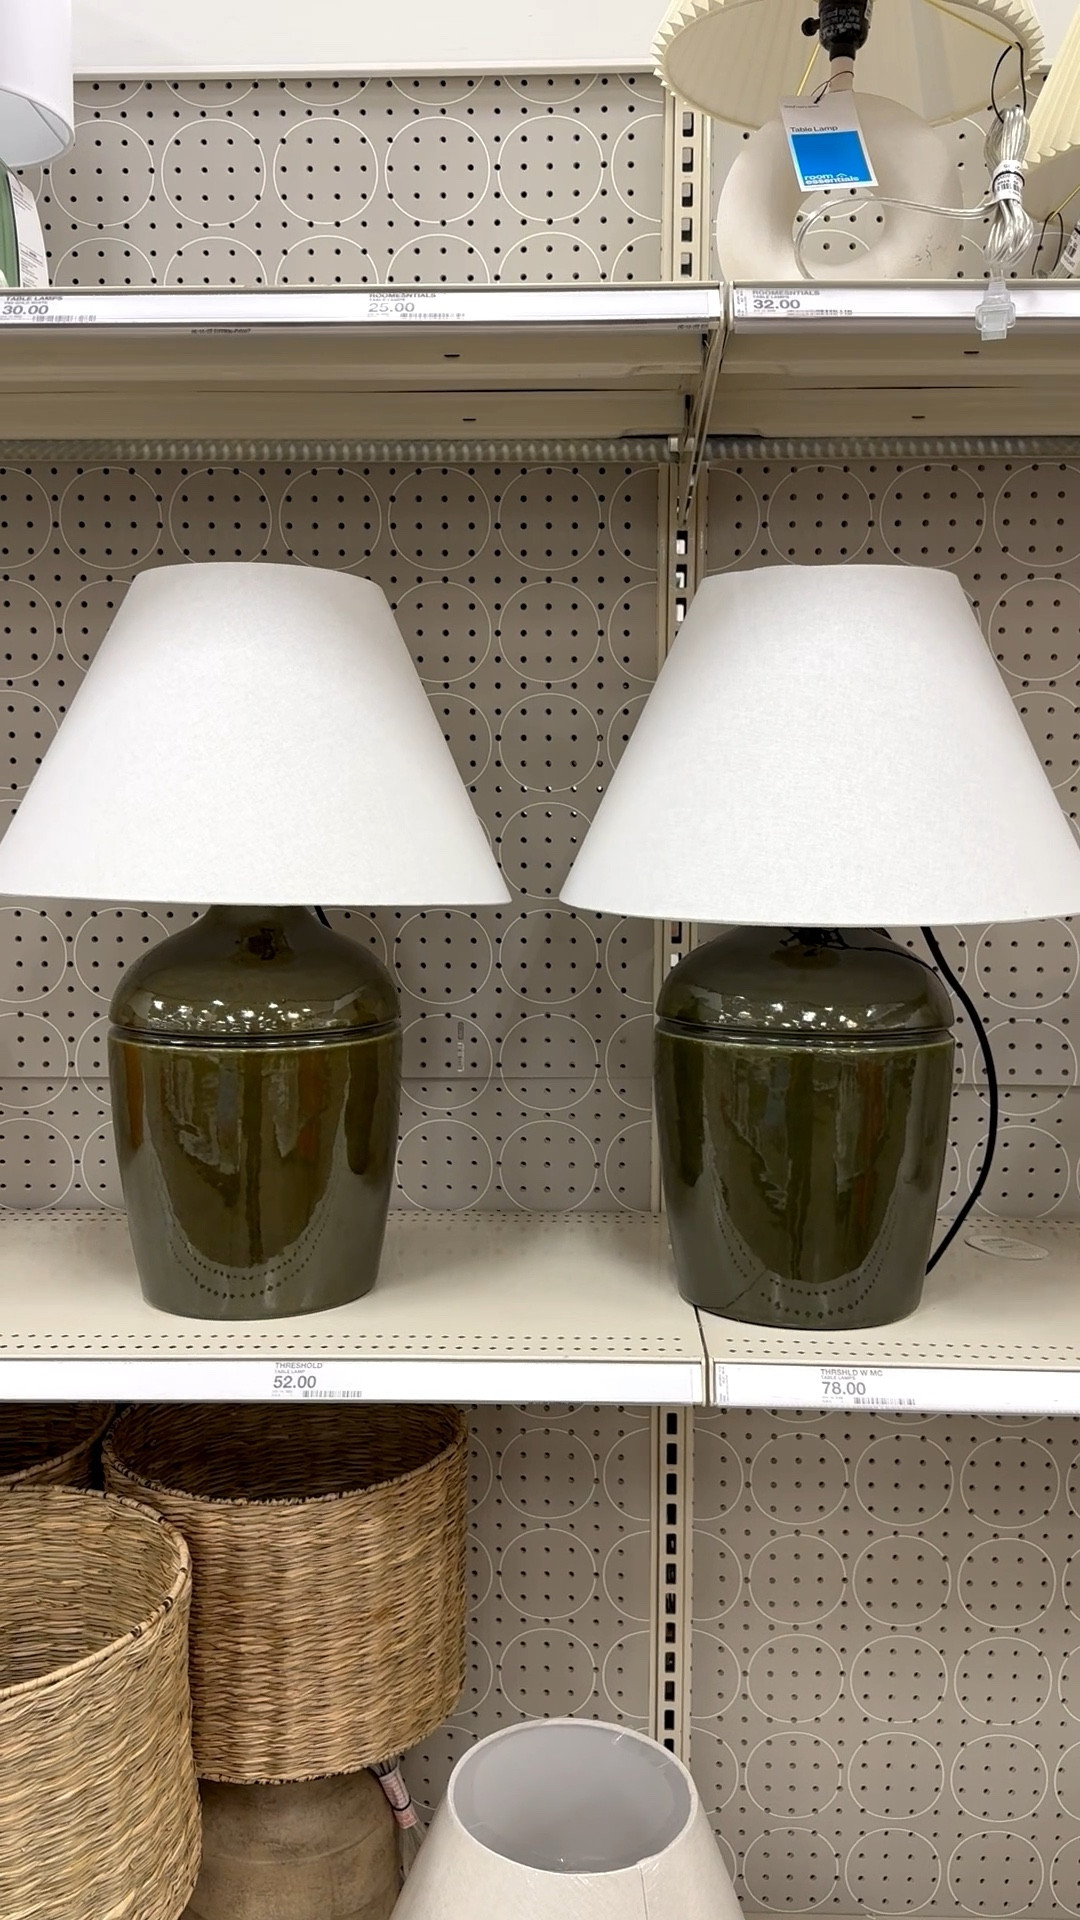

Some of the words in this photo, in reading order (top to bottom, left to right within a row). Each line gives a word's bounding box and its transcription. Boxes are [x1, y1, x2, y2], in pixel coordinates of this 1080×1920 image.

[804, 173, 834, 181] room
[805, 175, 860, 185] essentials
[368, 302, 415, 313] 25.00
[753, 299, 801, 309] 32.00
[2, 304, 49, 315] 30.00
[820, 1368, 859, 1376] THRSHLD
[869, 1369, 884, 1377] MC
[273, 1375, 317, 1389] 52.00
[821, 1381, 866, 1396] 78.00
